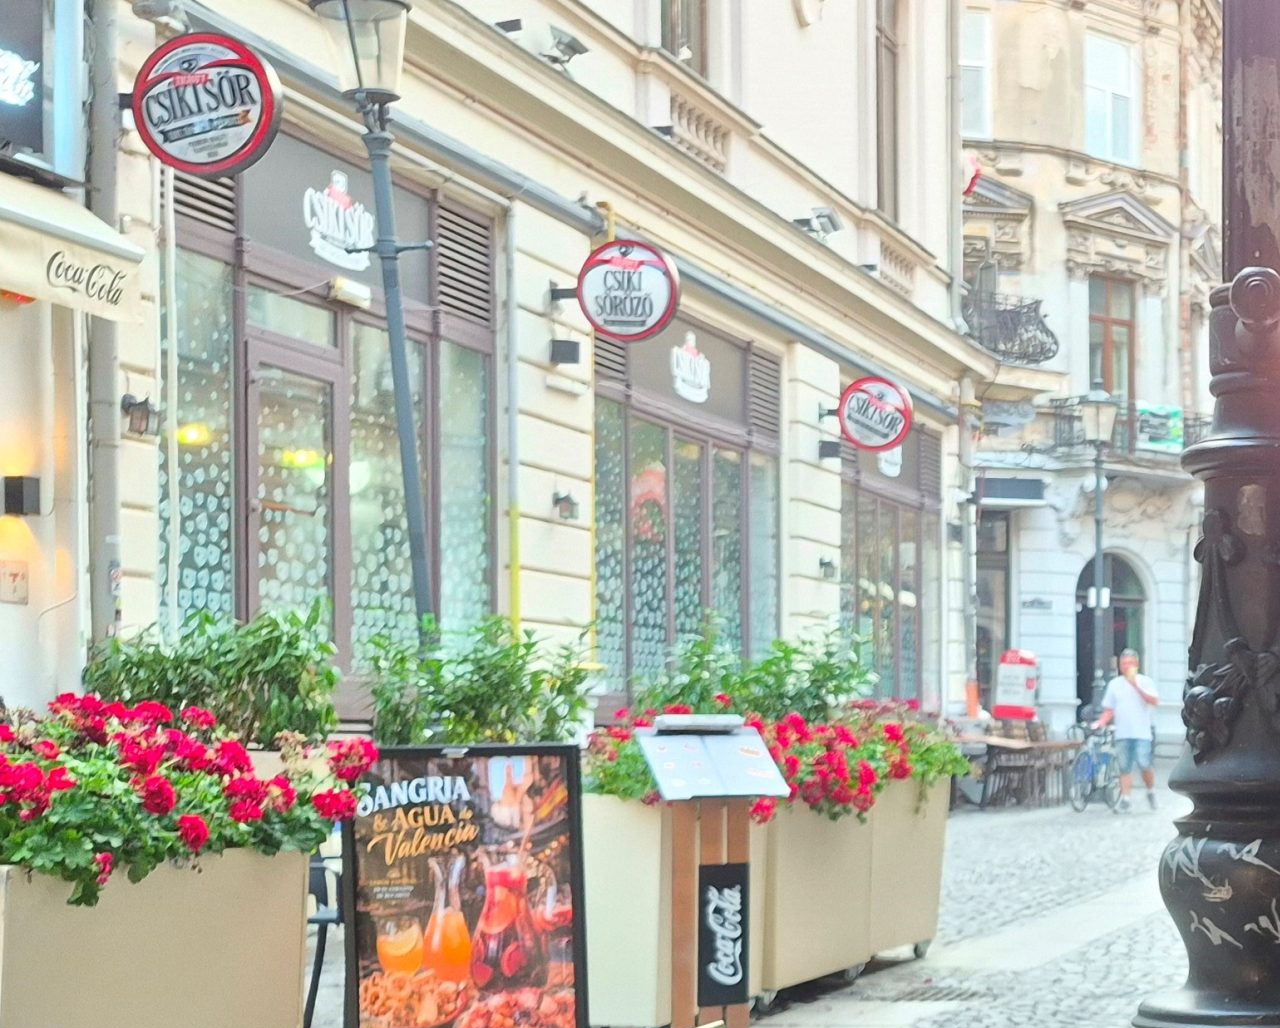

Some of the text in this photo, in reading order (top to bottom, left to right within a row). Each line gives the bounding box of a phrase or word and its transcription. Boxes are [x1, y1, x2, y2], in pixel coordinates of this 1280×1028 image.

[356, 775, 471, 818] SANGRIA
[391, 803, 457, 831] AGUA
[367, 820, 480, 866] Valencia
